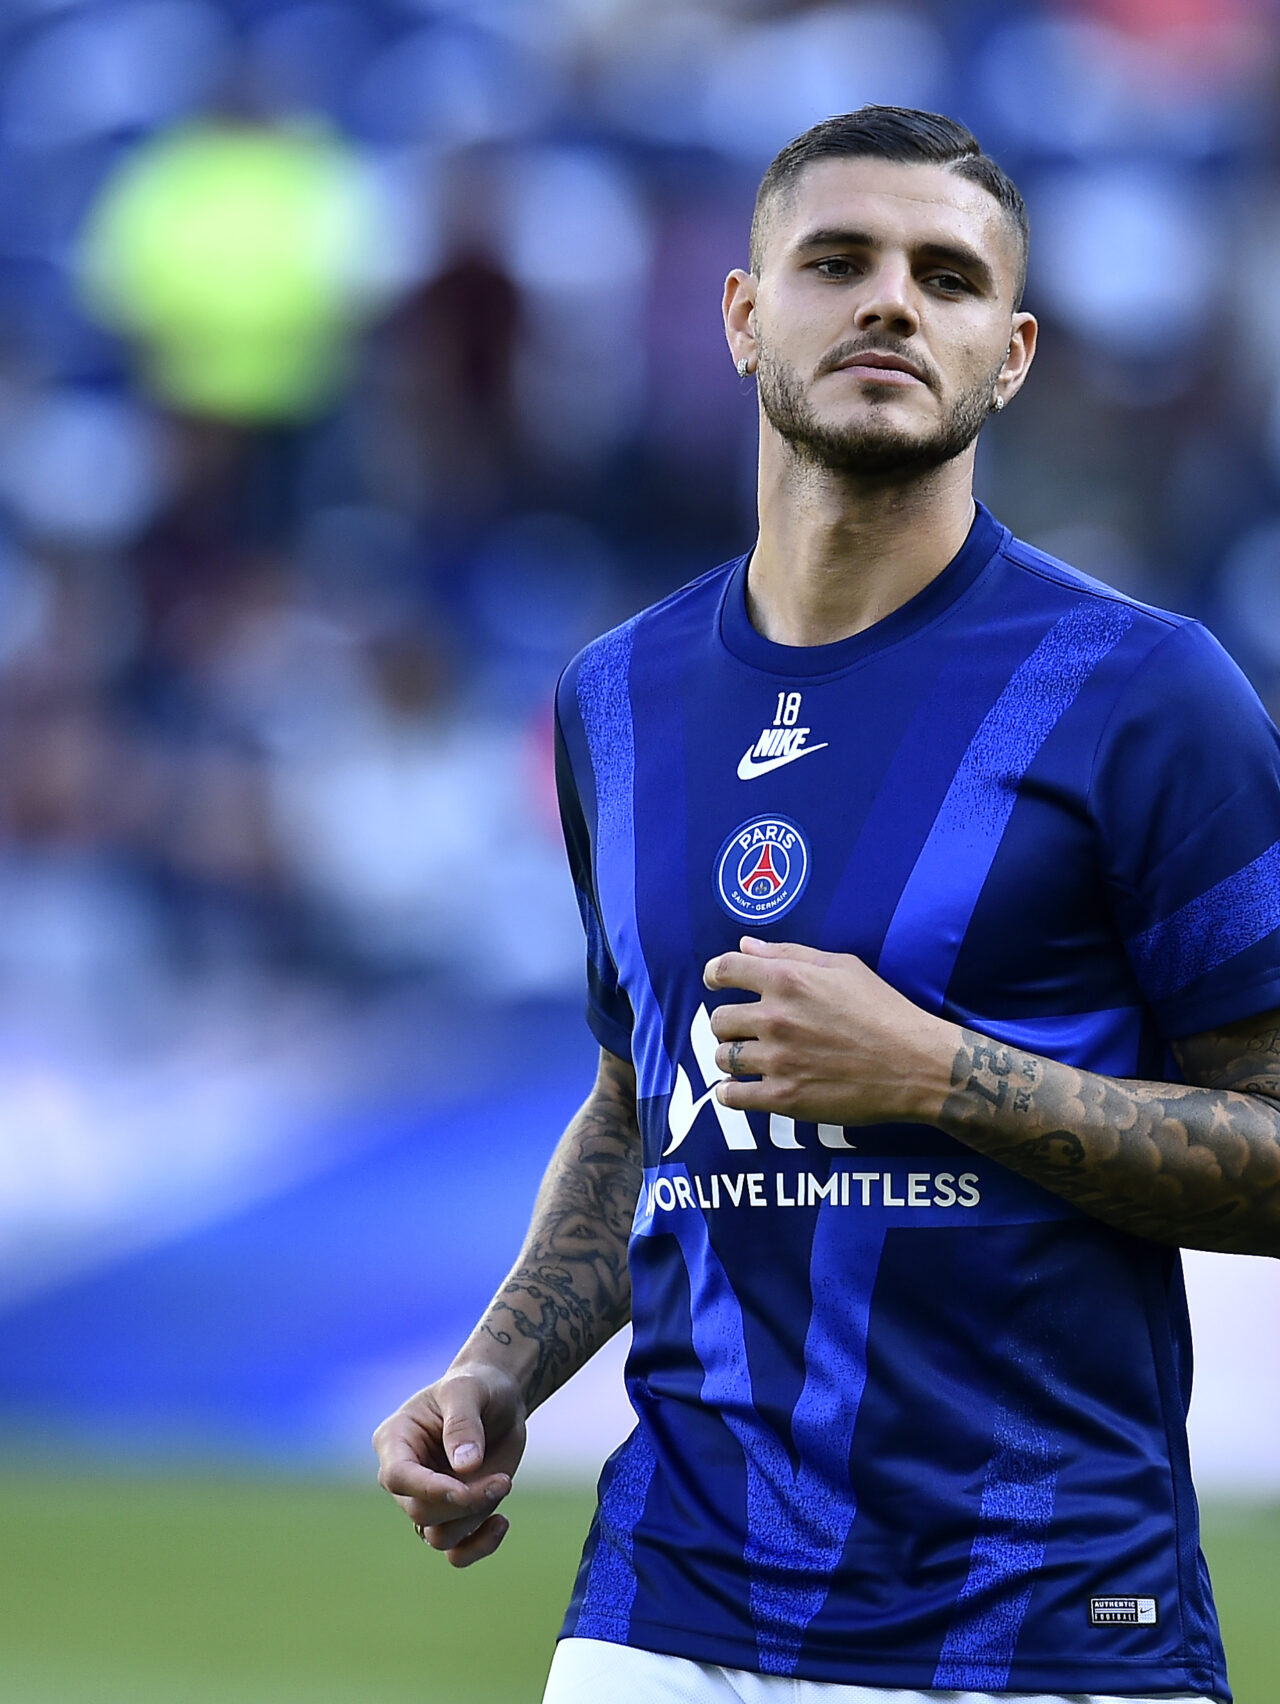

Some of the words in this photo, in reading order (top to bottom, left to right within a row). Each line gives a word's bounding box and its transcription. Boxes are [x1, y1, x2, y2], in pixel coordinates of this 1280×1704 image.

[773, 691, 802, 726] 18
[752, 727, 811, 758] NIKE
[738, 825, 797, 851] PARIS
[694, 1172, 768, 1209] LIVE
[775, 1171, 982, 1208] LIMITLESS
[1094, 1613, 1136, 1621] FOOTBALL
